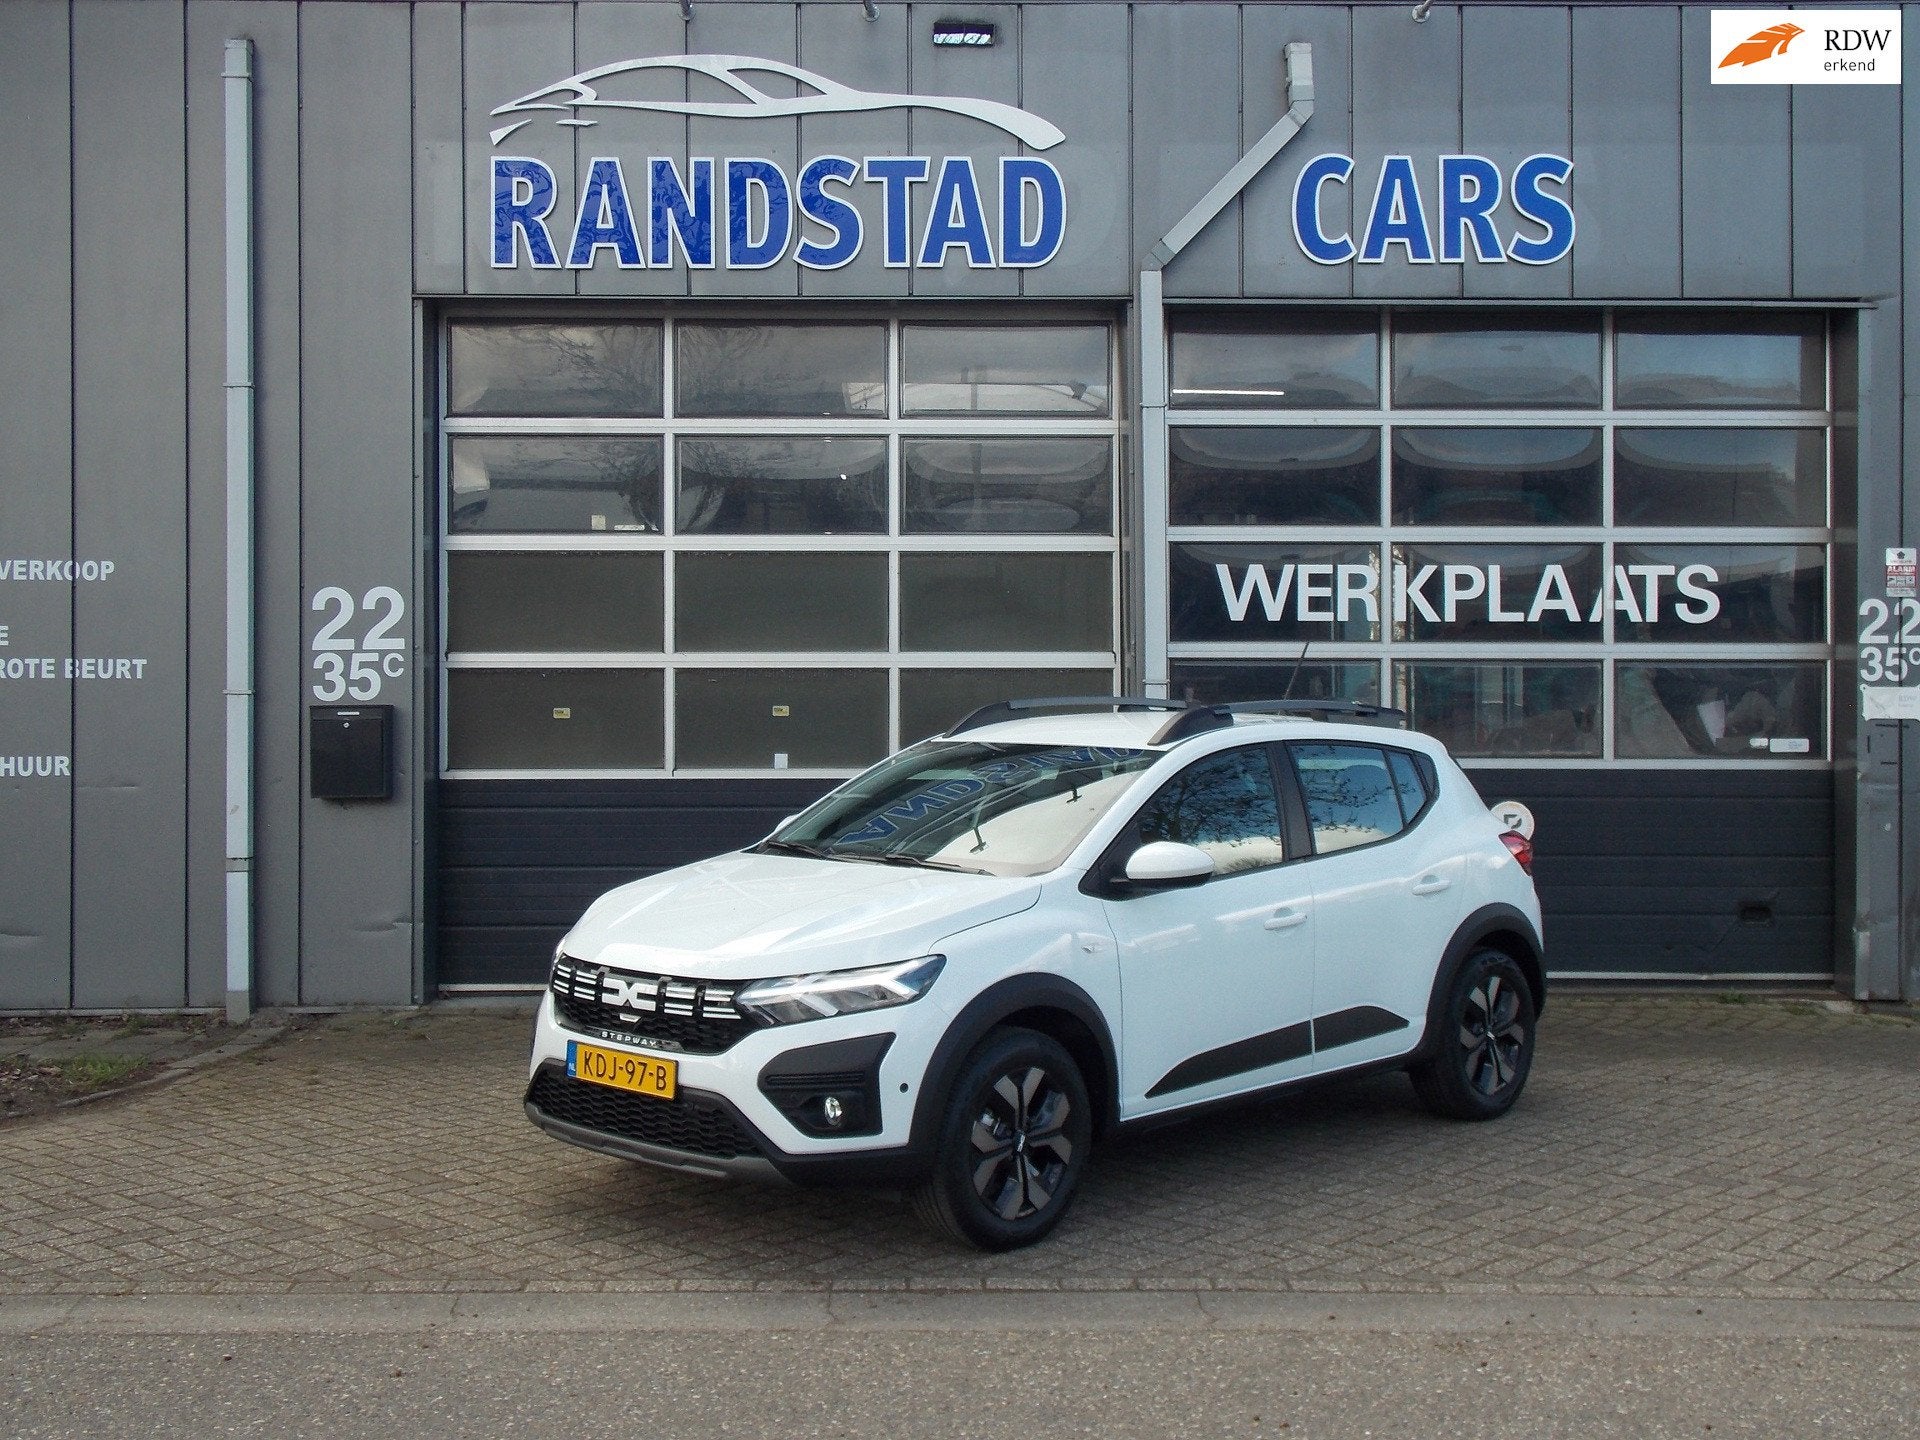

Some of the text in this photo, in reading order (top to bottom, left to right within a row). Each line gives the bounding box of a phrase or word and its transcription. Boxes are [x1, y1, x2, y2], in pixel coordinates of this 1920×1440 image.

[490, 152, 1576, 271] RANDSTAD CARS
[0, 560, 115, 582] VERKOOP
[1215, 563, 1722, 625] WERKPLAATS
[311, 586, 406, 651] 22
[1858, 598, 1920, 644] 22
[64, 658, 148, 680] BEURT
[601, 1031, 657, 1048] STEPWAY
[583, 1050, 667, 1091] KDJ-97-B
